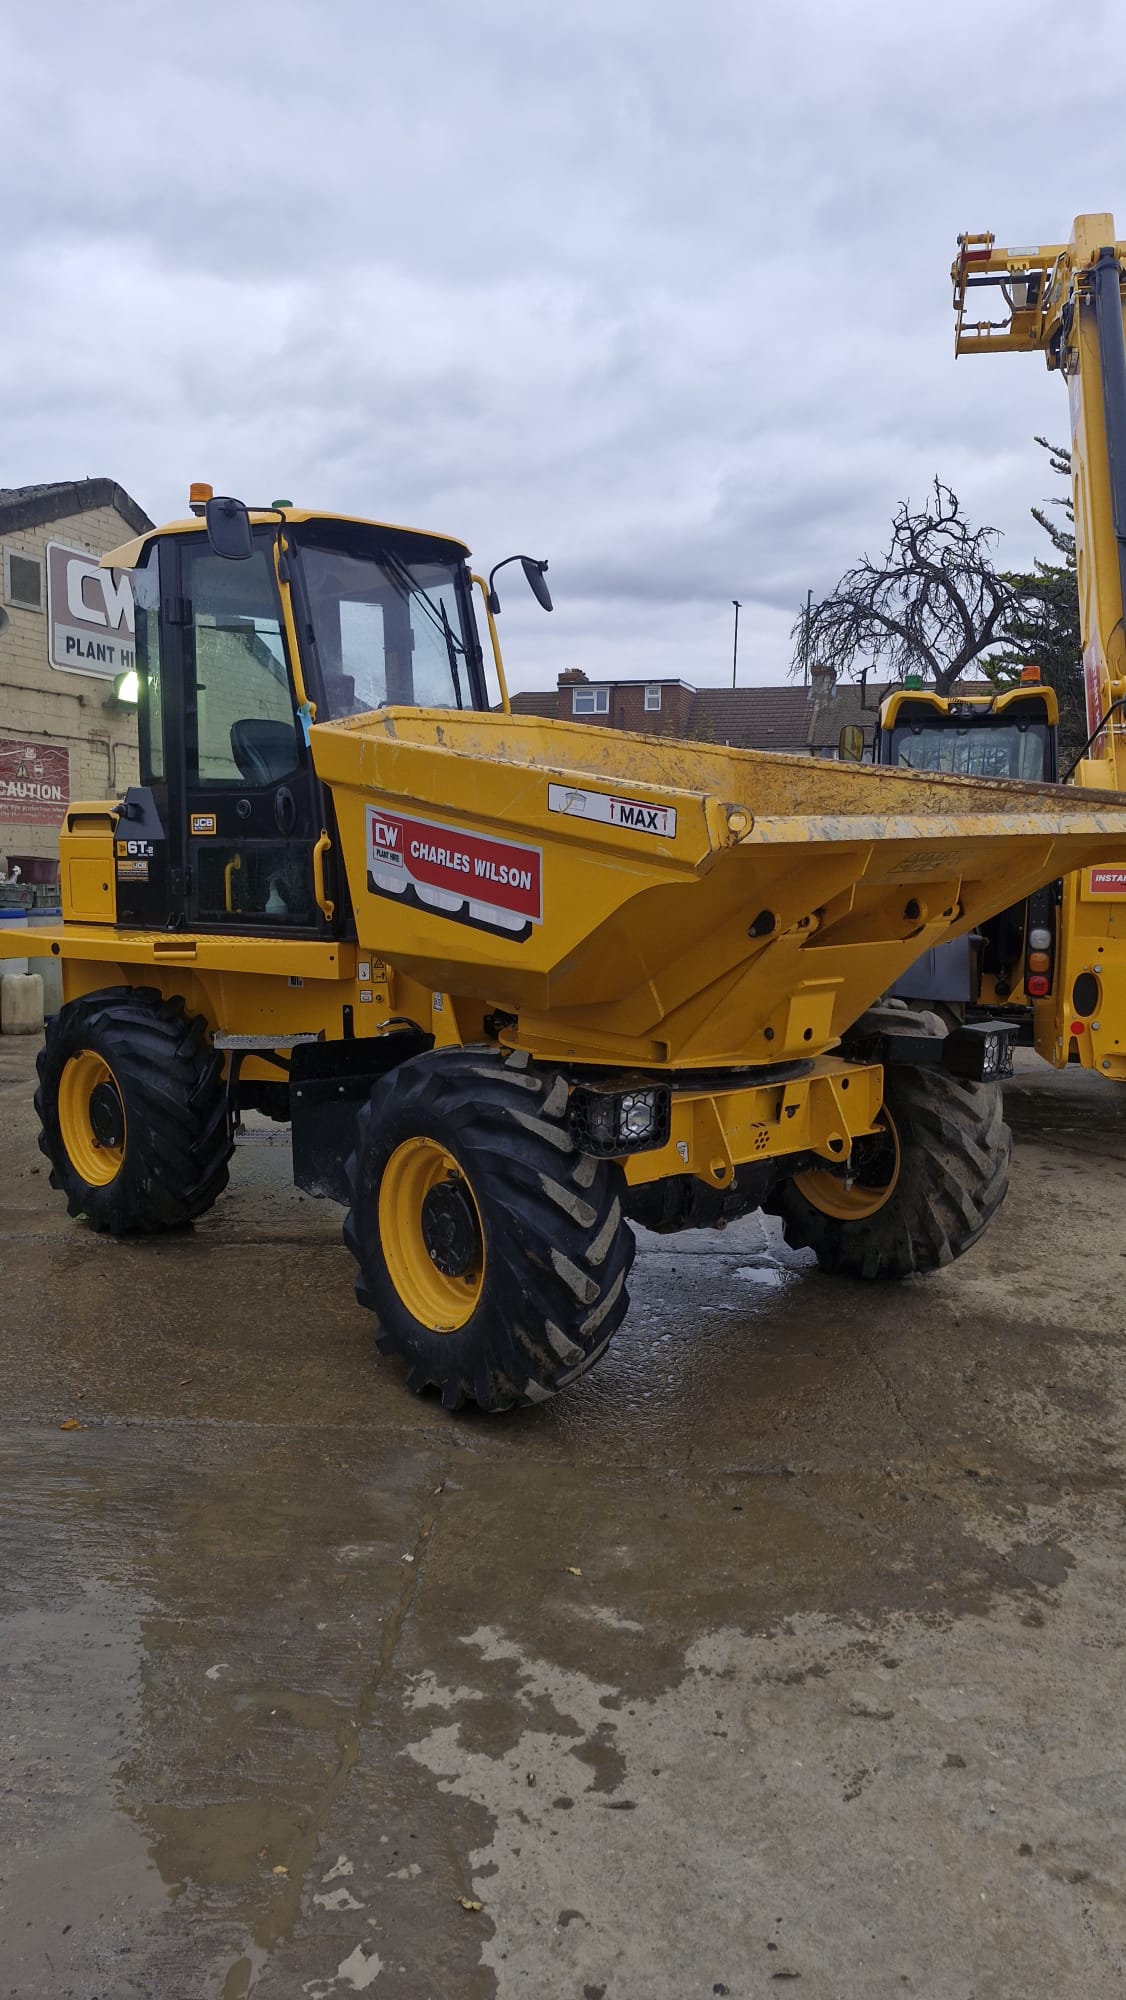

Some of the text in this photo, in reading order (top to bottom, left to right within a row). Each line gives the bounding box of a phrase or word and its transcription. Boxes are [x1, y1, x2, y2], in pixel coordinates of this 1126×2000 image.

[66, 559, 136, 634] CW
[66, 635, 136, 668] PLANT HI
[194, 818, 213, 827] JCB
[620, 806, 658, 830] MAX
[375, 822, 398, 848] CW
[410, 840, 532, 891] CHARLES WILSON
